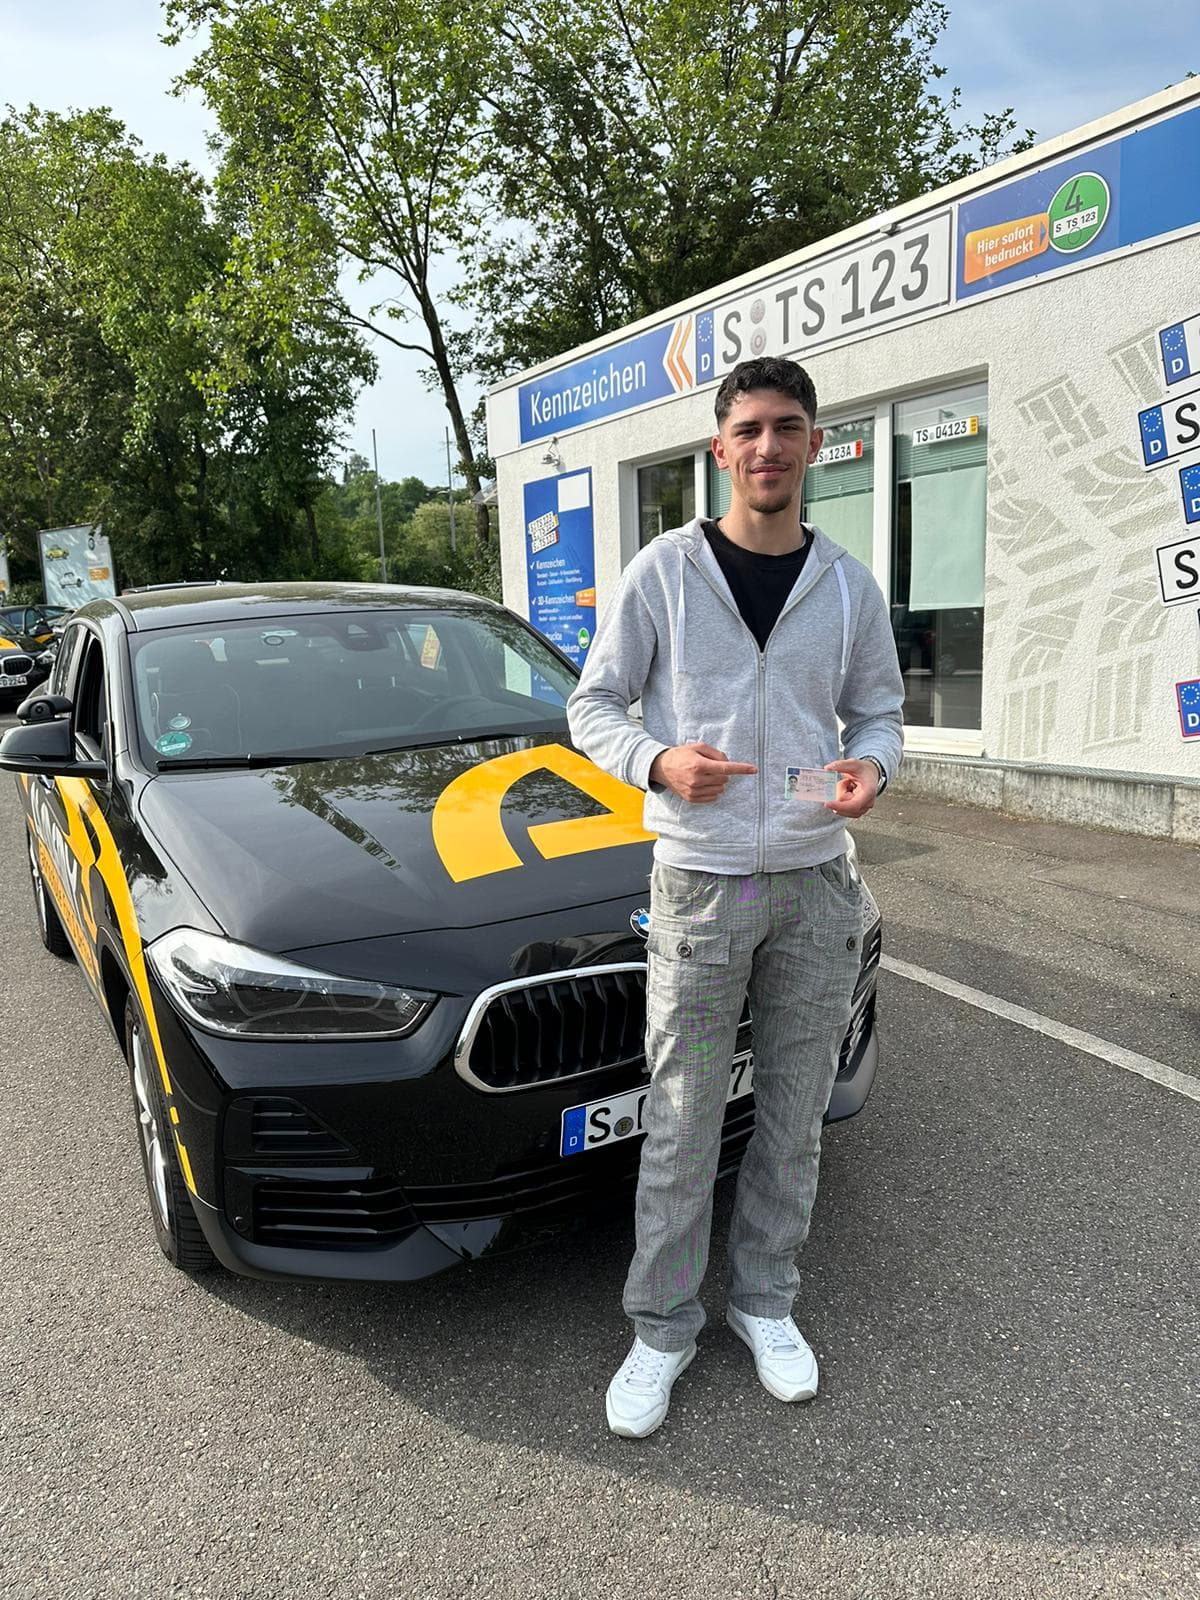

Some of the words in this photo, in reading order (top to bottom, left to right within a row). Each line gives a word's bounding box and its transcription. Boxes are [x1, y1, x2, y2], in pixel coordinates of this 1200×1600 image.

[1064, 179, 1084, 213] 4
[1055, 223, 1062, 233] S
[1067, 217, 1078, 229] TS
[1081, 212, 1096, 225] 123
[976, 239, 999, 255] Hier
[1002, 223, 1034, 245] sofort
[984, 239, 1034, 267] bedruckt
[701, 353, 711, 372] D
[722, 310, 743, 365] S
[775, 277, 826, 345] TS
[841, 233, 930, 325] 123
[1171, 357, 1184, 374] D
[530, 359, 647, 427] Kennzeichen
[916, 428, 929, 443] TS
[935, 420, 968, 439] 04123
[1149, 439, 1162, 455] D
[1175, 402, 1200, 444] S
[816, 451, 824, 463] S
[829, 444, 852, 460] 123A
[536, 558, 566, 570] Kennzeichen
[1174, 550, 1199, 590] S
[1187, 713, 1200, 728] D
[569, 1136, 578, 1147] D
[588, 1107, 612, 1143] S
